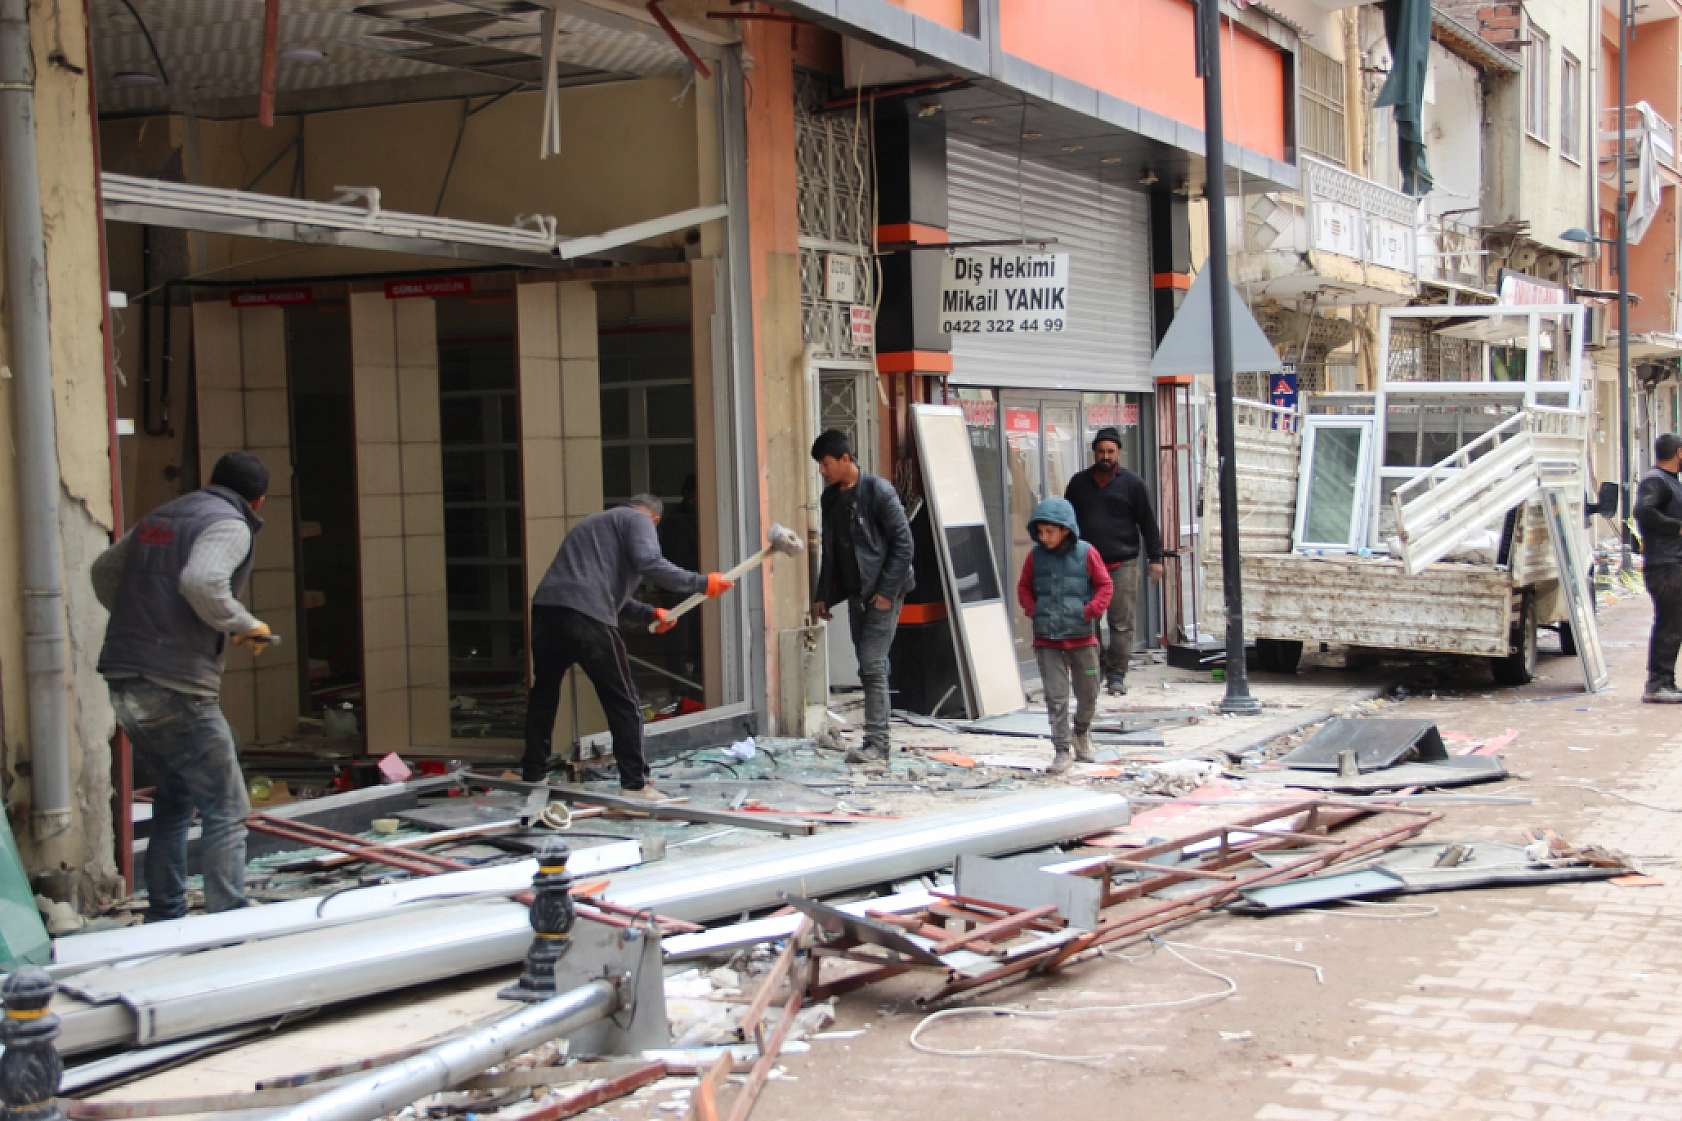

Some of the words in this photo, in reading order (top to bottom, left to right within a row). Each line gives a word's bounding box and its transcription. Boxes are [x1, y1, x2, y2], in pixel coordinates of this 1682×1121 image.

[955, 257, 983, 286] Diş
[990, 255, 1055, 279] Hekimi
[943, 289, 998, 312] Mikail
[1005, 287, 1065, 311] YANIK
[943, 319, 981, 333] 0422
[986, 319, 1014, 332] 322
[1019, 319, 1038, 332] 44
[1044, 318, 1063, 331] 99
